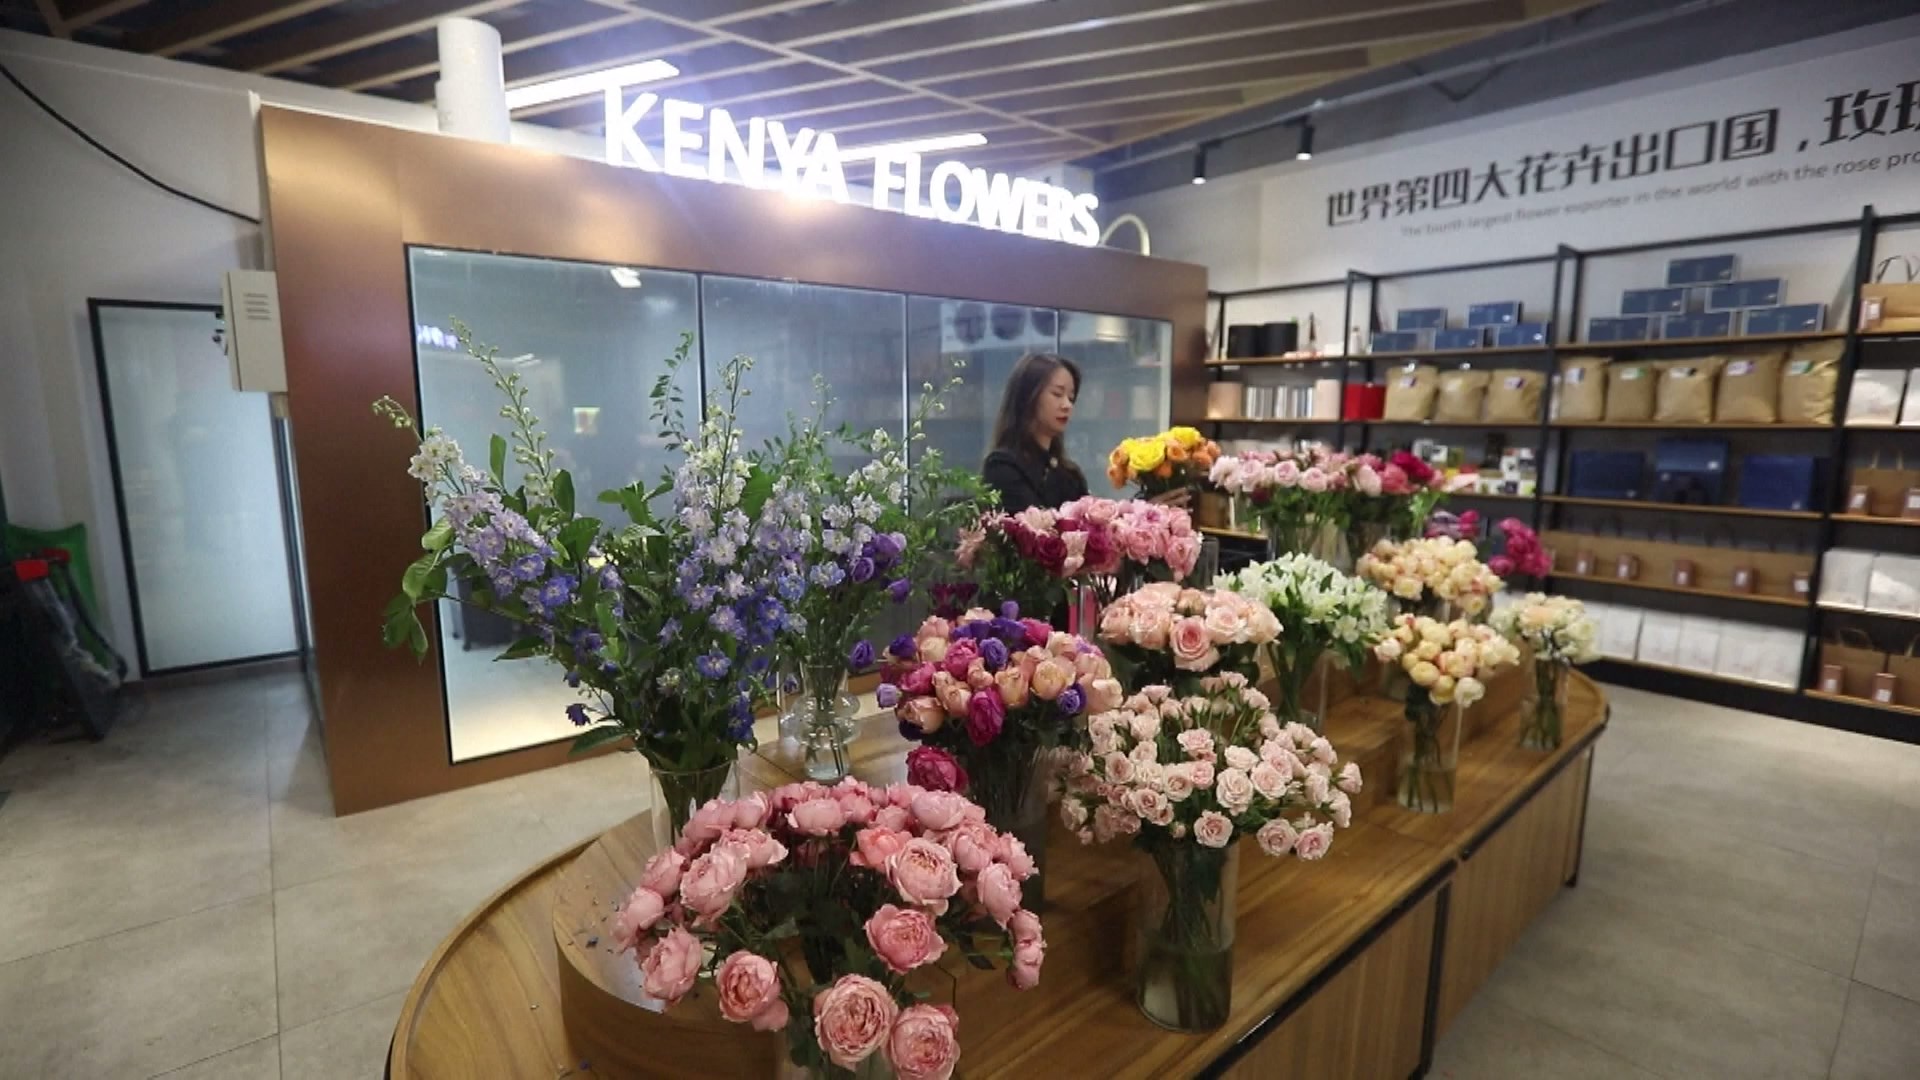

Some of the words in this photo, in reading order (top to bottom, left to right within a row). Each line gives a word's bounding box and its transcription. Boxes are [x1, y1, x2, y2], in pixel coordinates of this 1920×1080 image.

[604, 81, 848, 203] KENYA
[873, 152, 1100, 247] FLOWERS
[1688, 176, 1742, 194] world
[1746, 167, 1789, 187] with
[1794, 162, 1829, 179] the
[1833, 156, 1881, 176] rose
